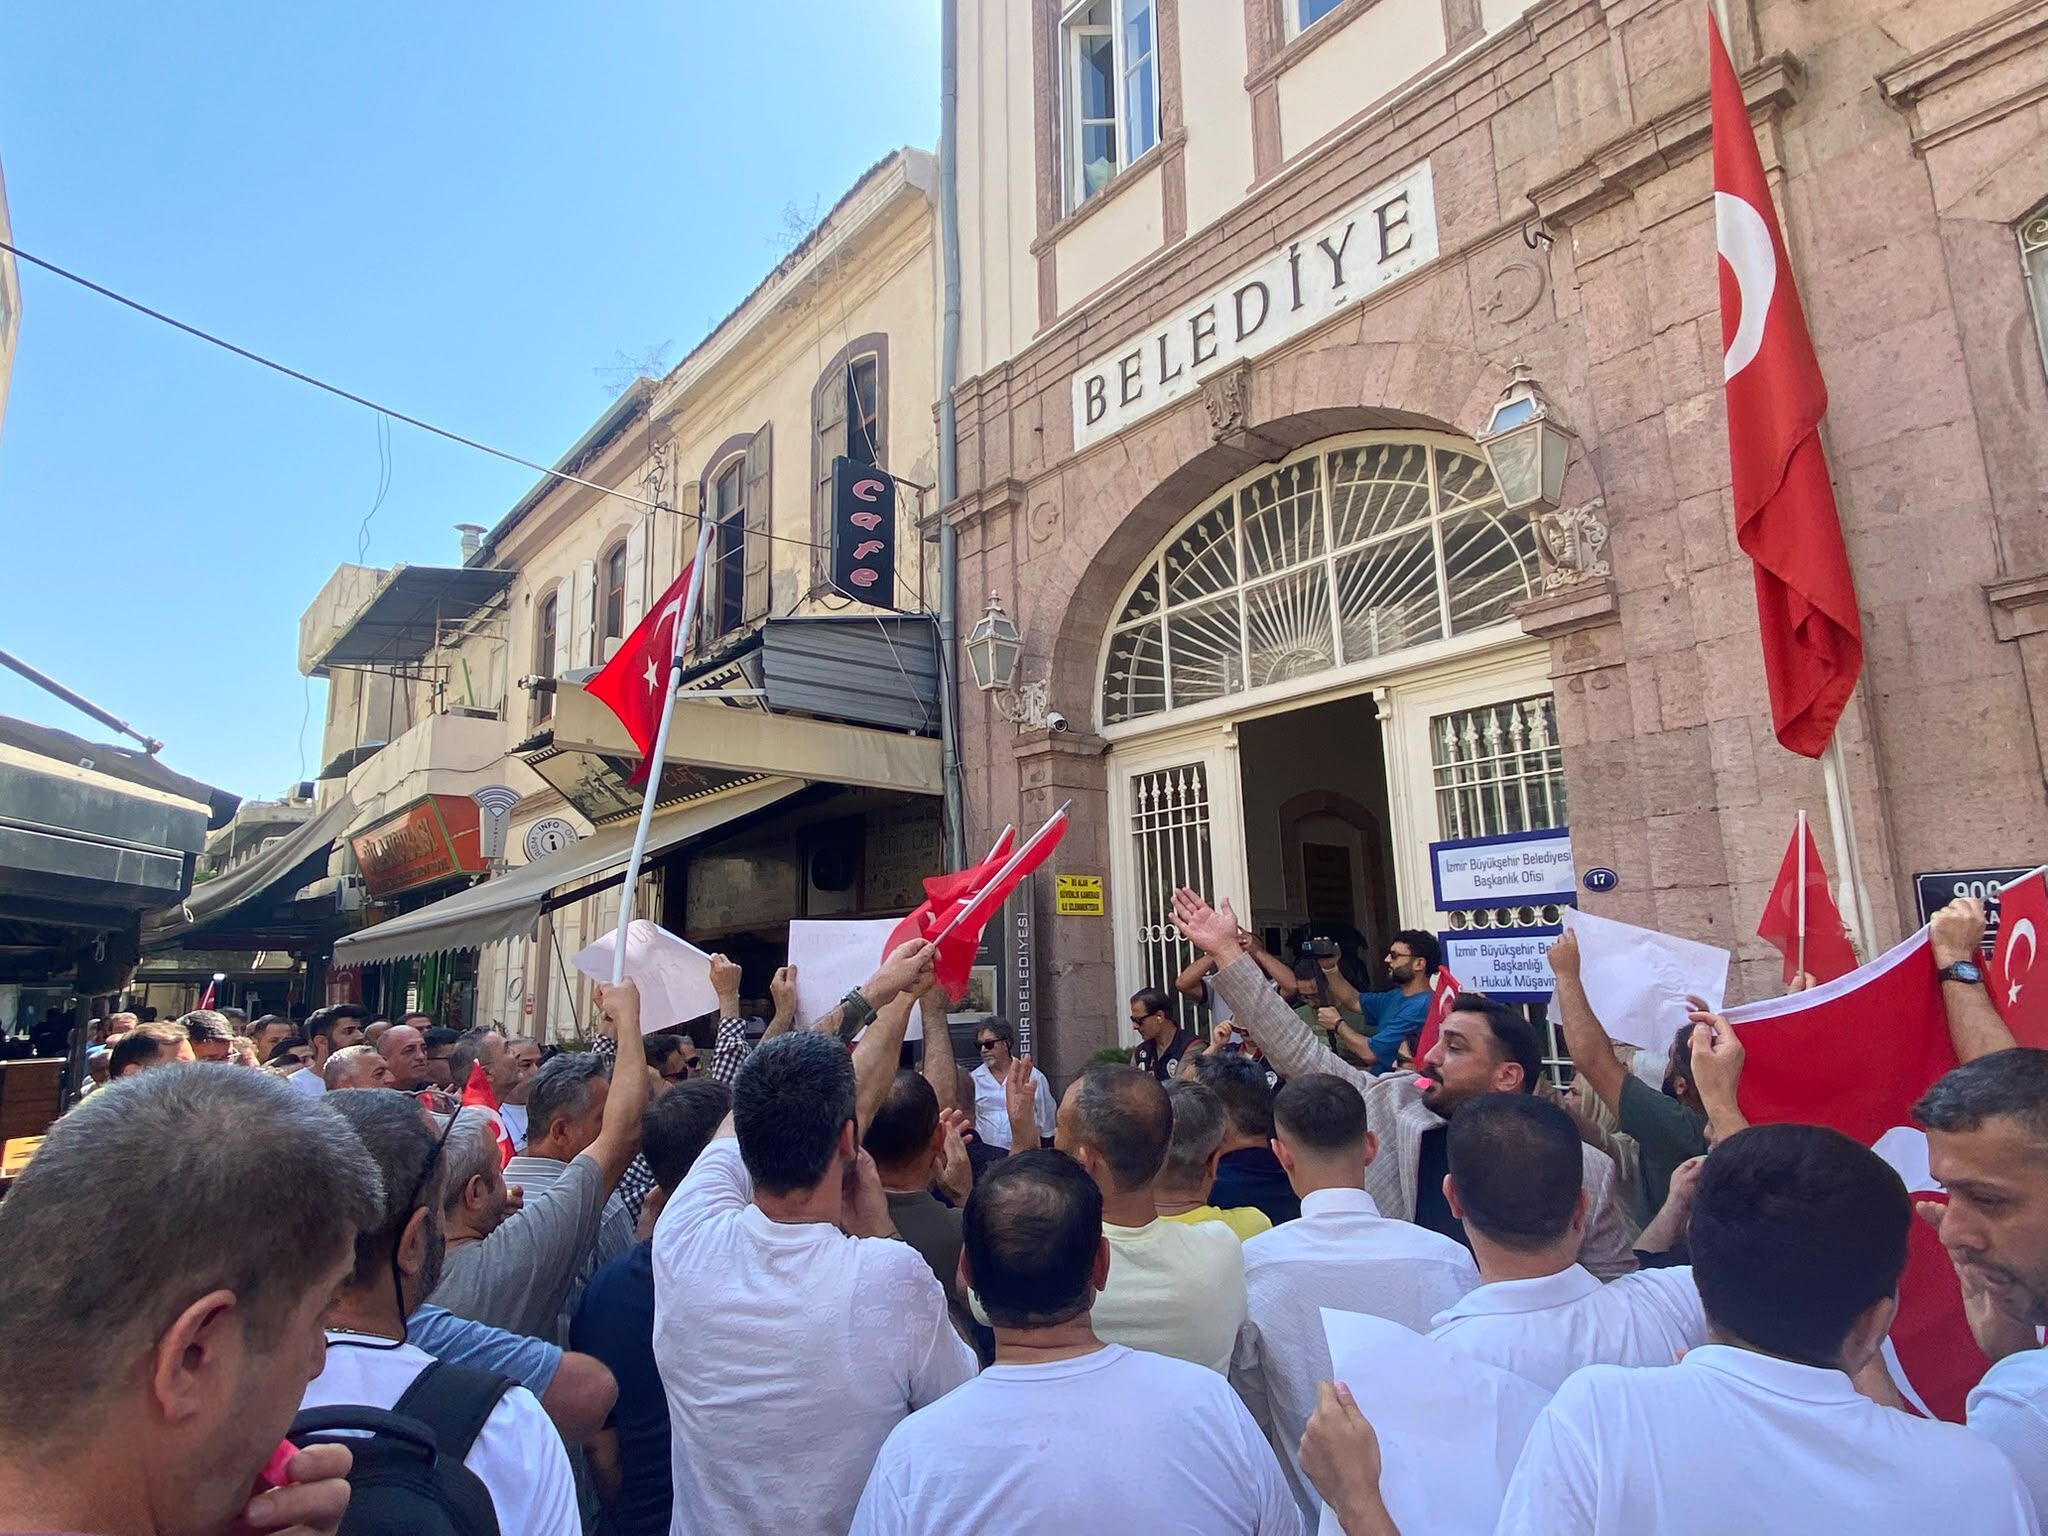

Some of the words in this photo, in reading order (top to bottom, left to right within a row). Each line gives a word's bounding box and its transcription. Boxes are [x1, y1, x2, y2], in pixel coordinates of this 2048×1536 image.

[1084, 190, 1413, 426] BELEDİYE
[850, 479, 885, 587] Cafe
[538, 821, 560, 832] INFO
[1445, 859, 1467, 873] İzmir
[1470, 856, 1520, 872] Büyükşehir
[1522, 850, 1571, 866] Belediyesi
[1474, 873, 1519, 888] Başkanlık
[1521, 869, 1544, 883] Ofisi
[1592, 873, 1606, 886] 17
[1455, 942, 1478, 957] İzmir
[1480, 944, 1535, 958] Büyükşehir
[1493, 959, 1543, 974] Başkanlığı
[1515, 975, 1556, 990] Müşavir
